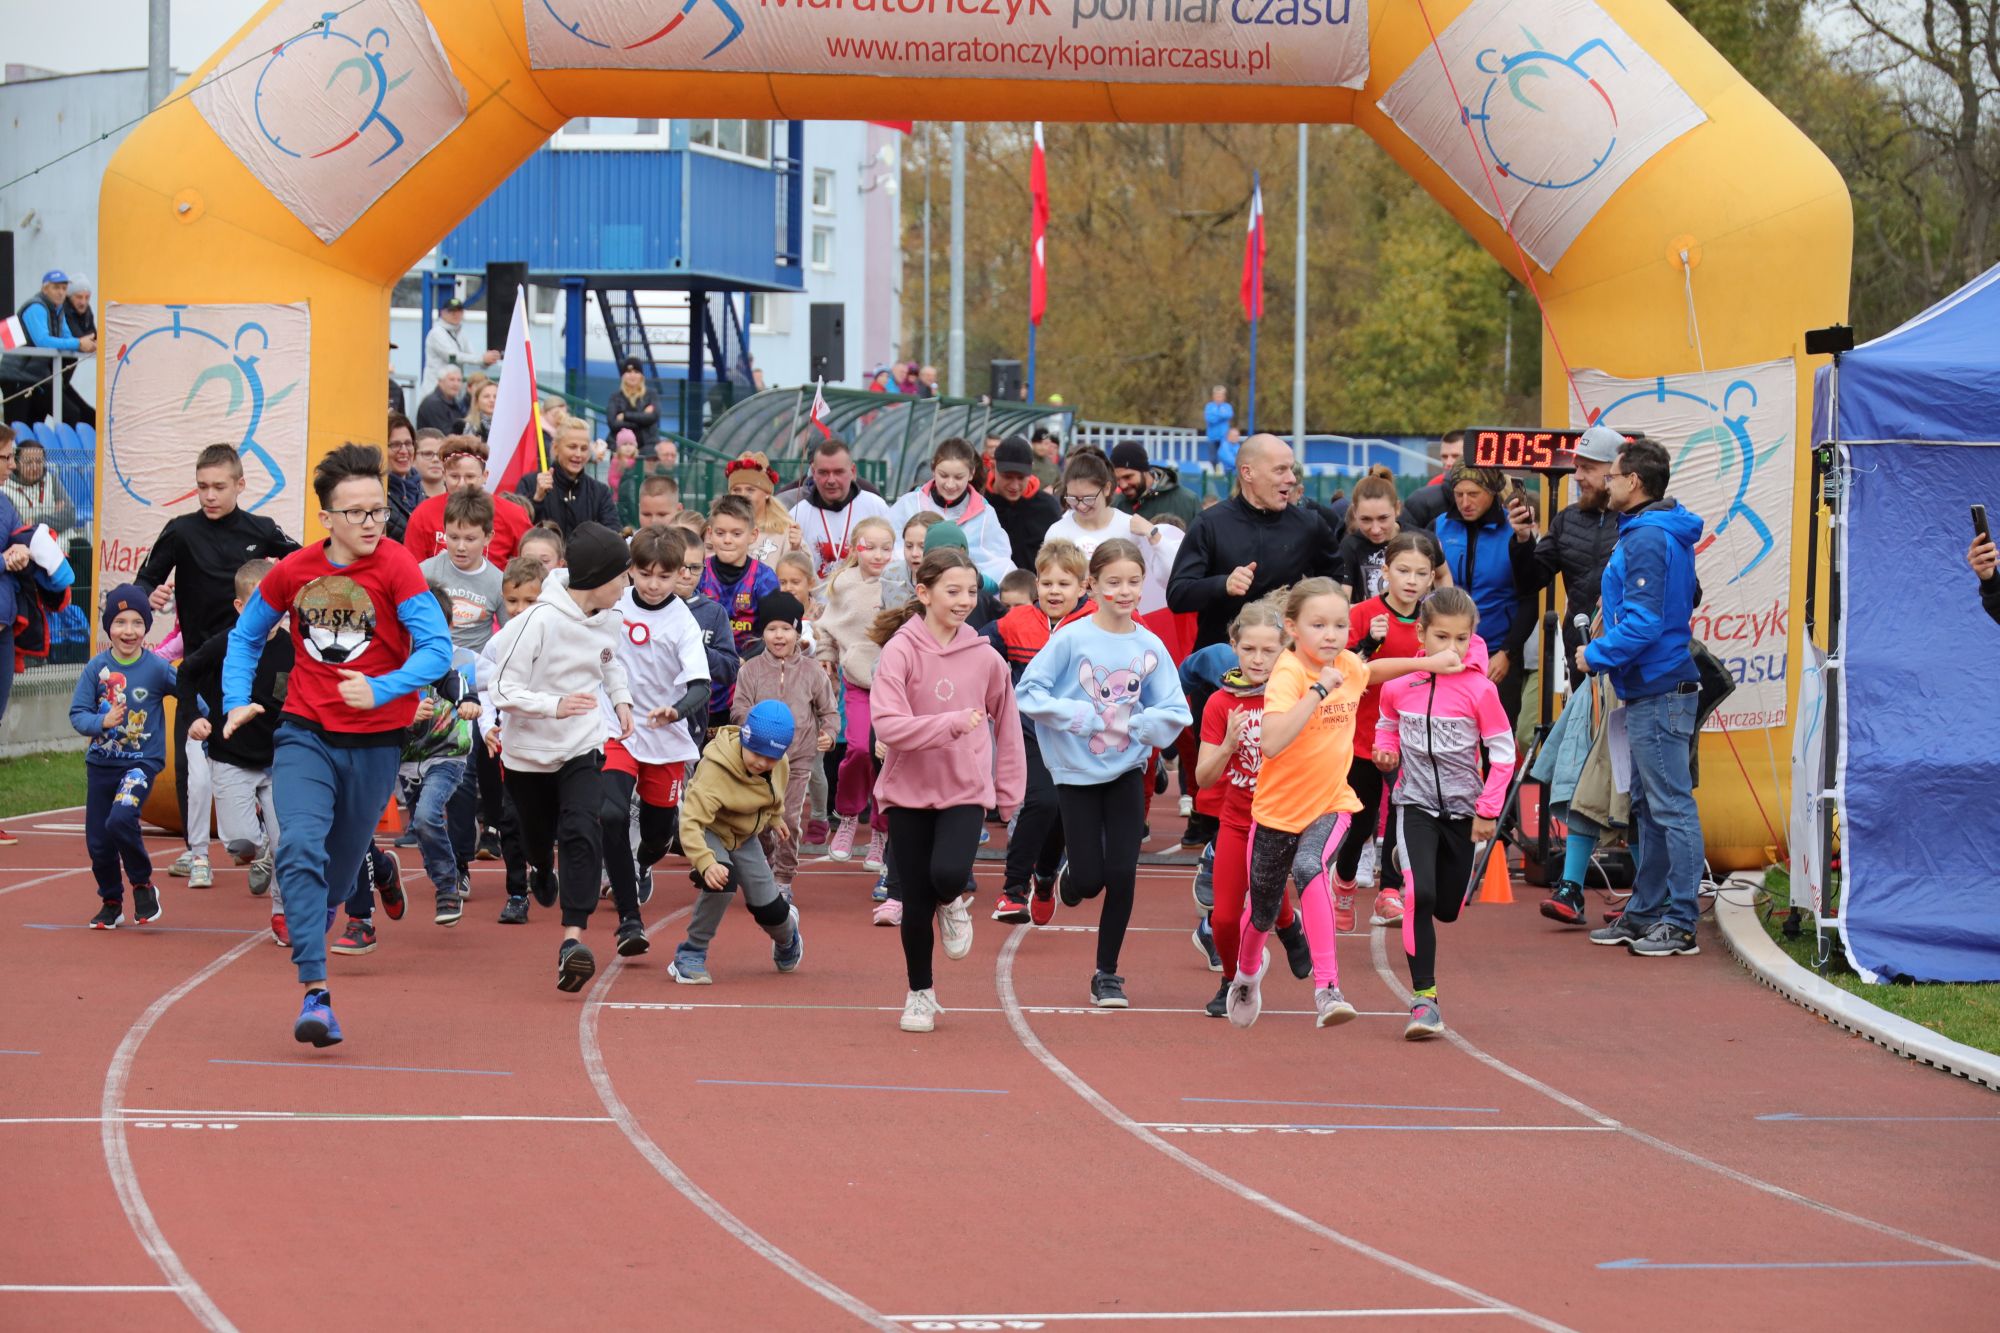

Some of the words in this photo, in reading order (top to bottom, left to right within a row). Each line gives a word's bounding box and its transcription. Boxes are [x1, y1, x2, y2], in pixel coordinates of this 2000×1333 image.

[826, 35, 1270, 75] www.maratonczykpomiarczasu.pl
[729, 619, 752, 631] ten
[1403, 716, 1457, 730] OREVER
